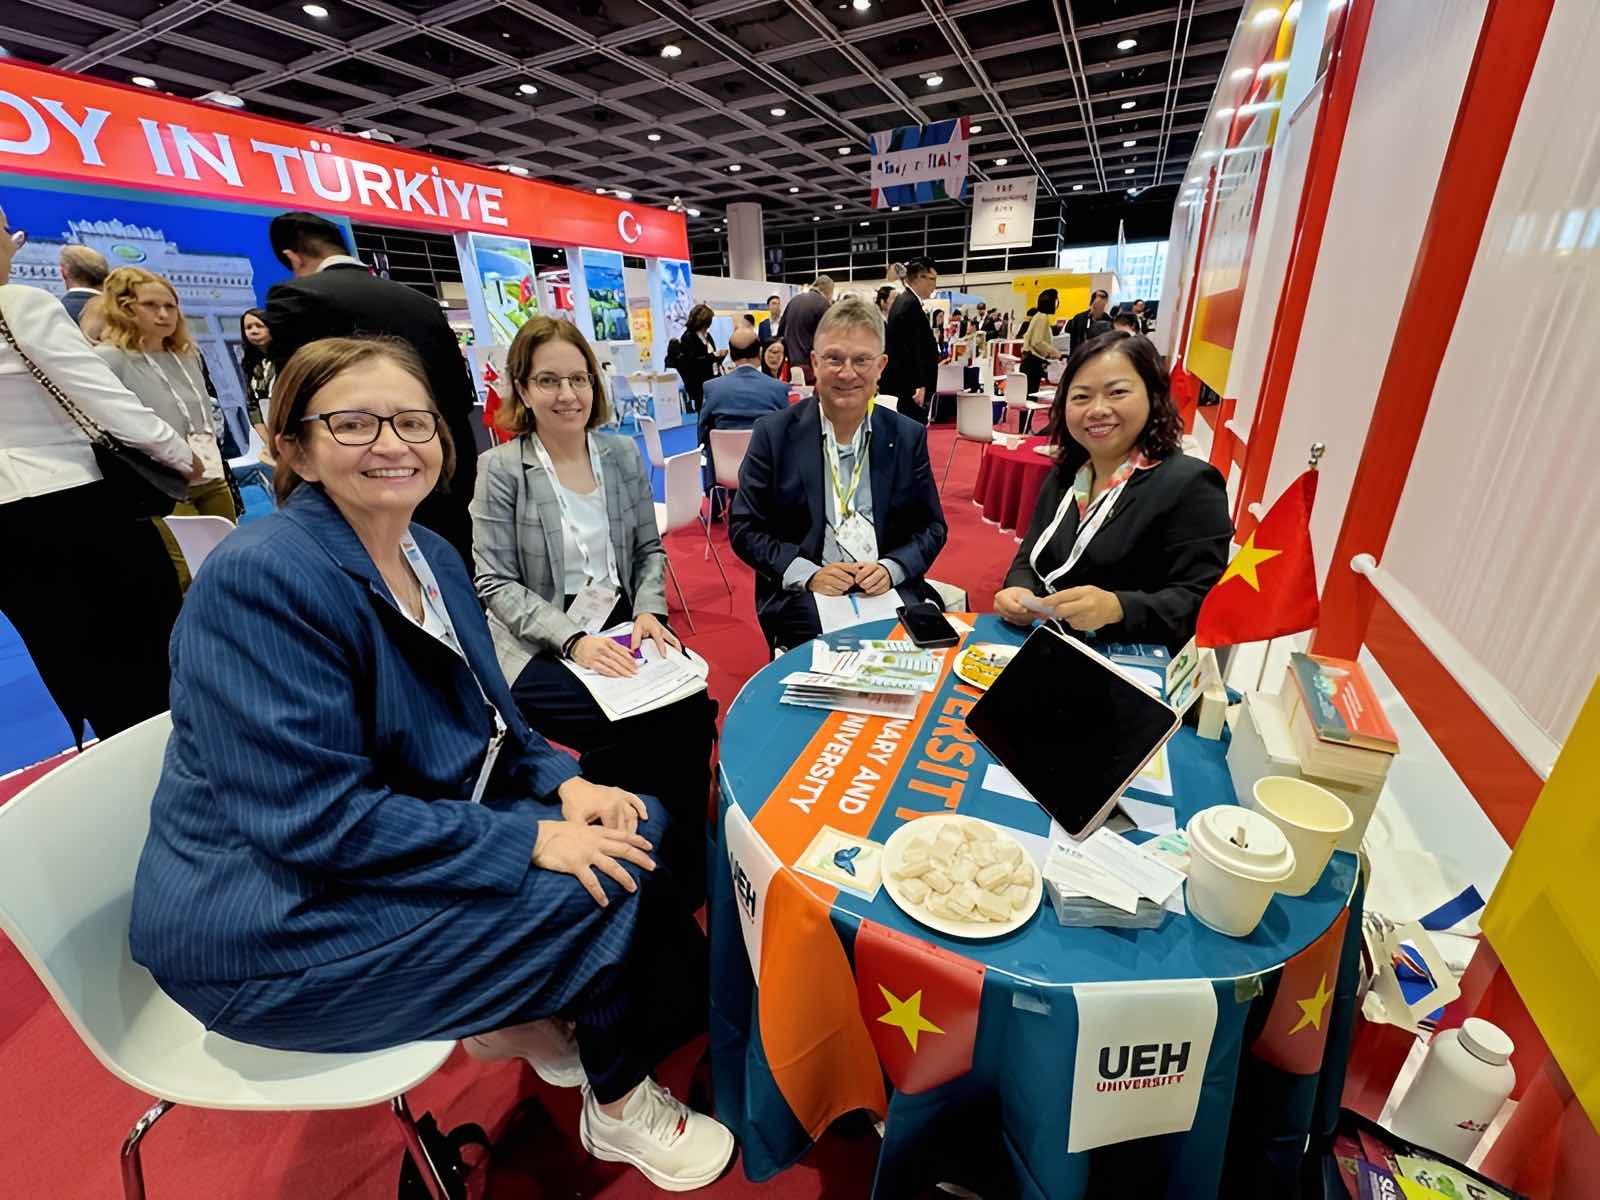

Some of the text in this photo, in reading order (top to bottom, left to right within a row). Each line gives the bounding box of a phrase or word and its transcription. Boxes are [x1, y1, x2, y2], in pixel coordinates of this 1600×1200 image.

[137, 117, 244, 188] IN
[250, 137, 509, 228] TÜRKİYE
[838, 764, 881, 815] AND
[1096, 1073, 1185, 1093] UNIVERSITY
[1098, 1041, 1192, 1081] UEH
